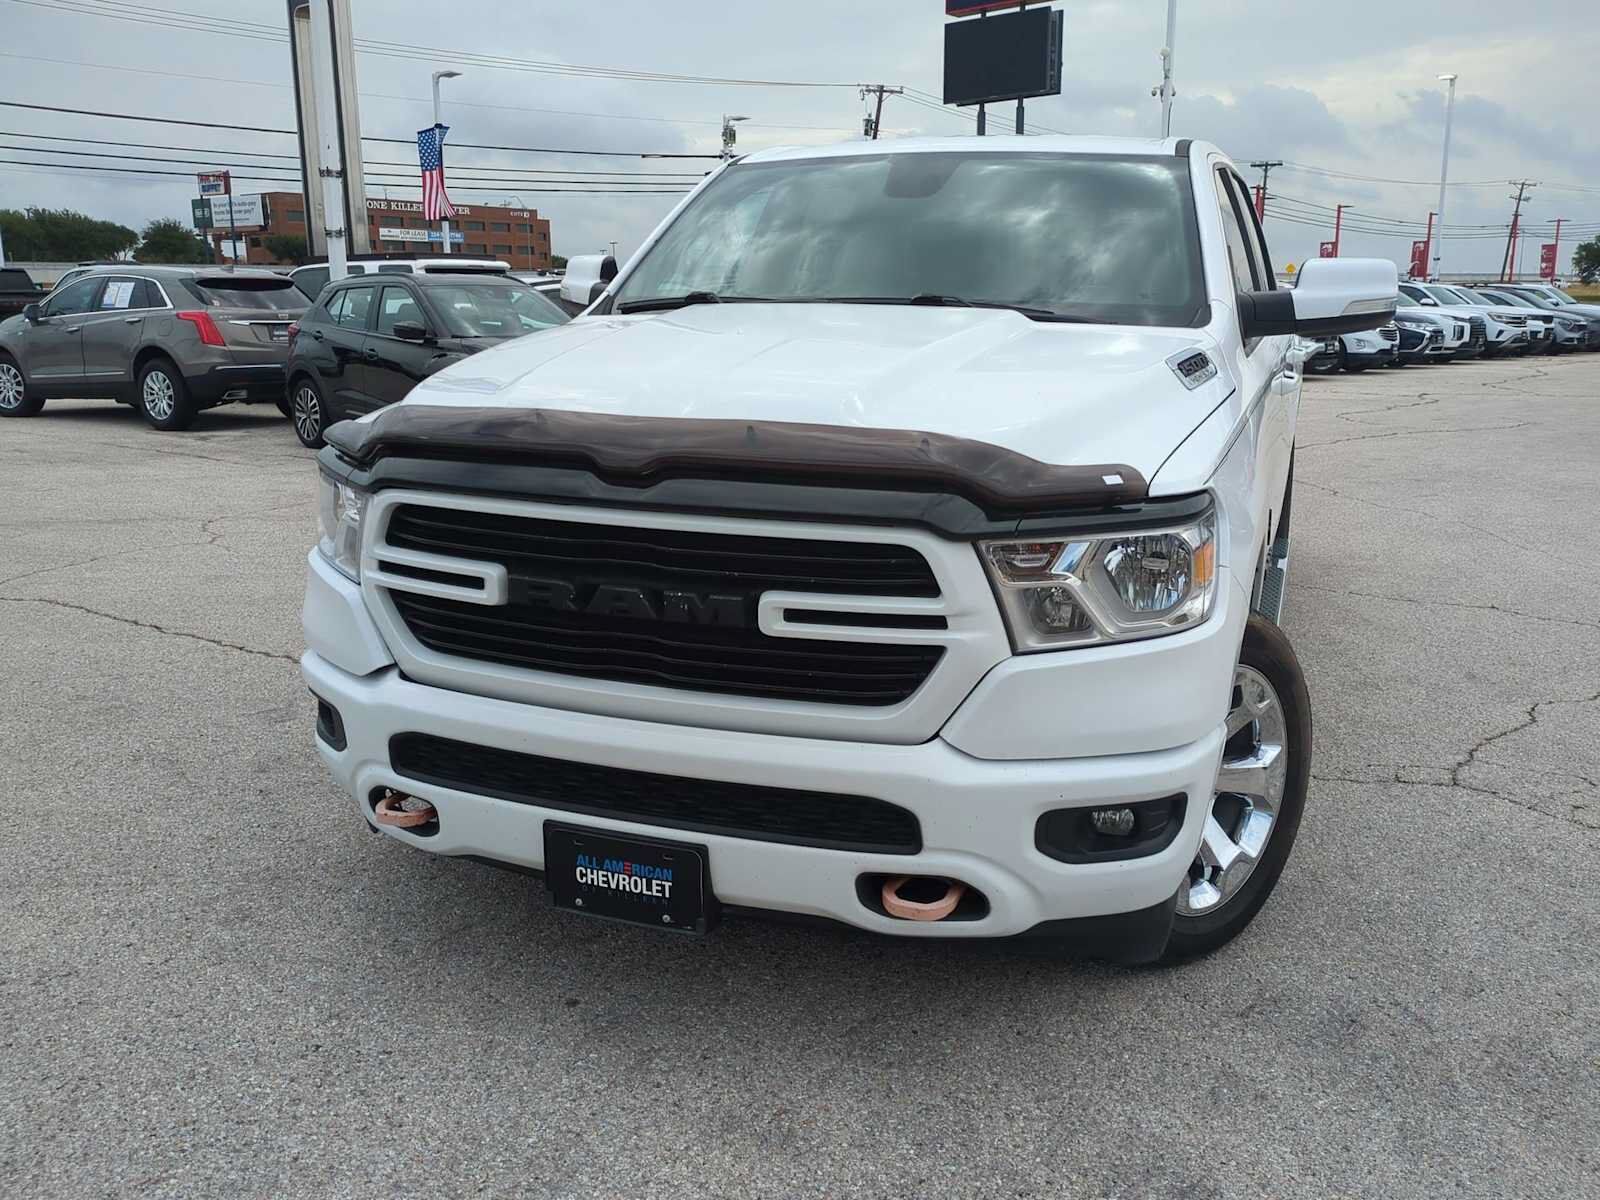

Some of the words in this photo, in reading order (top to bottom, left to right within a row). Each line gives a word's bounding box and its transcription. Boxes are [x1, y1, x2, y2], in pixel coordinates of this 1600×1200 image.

[366, 199, 388, 210] ONE
[509, 575, 745, 627] RAM
[575, 866, 673, 899] CHEVROLET
[576, 854, 600, 870] ALL
[603, 859, 673, 881] AMERICAN
